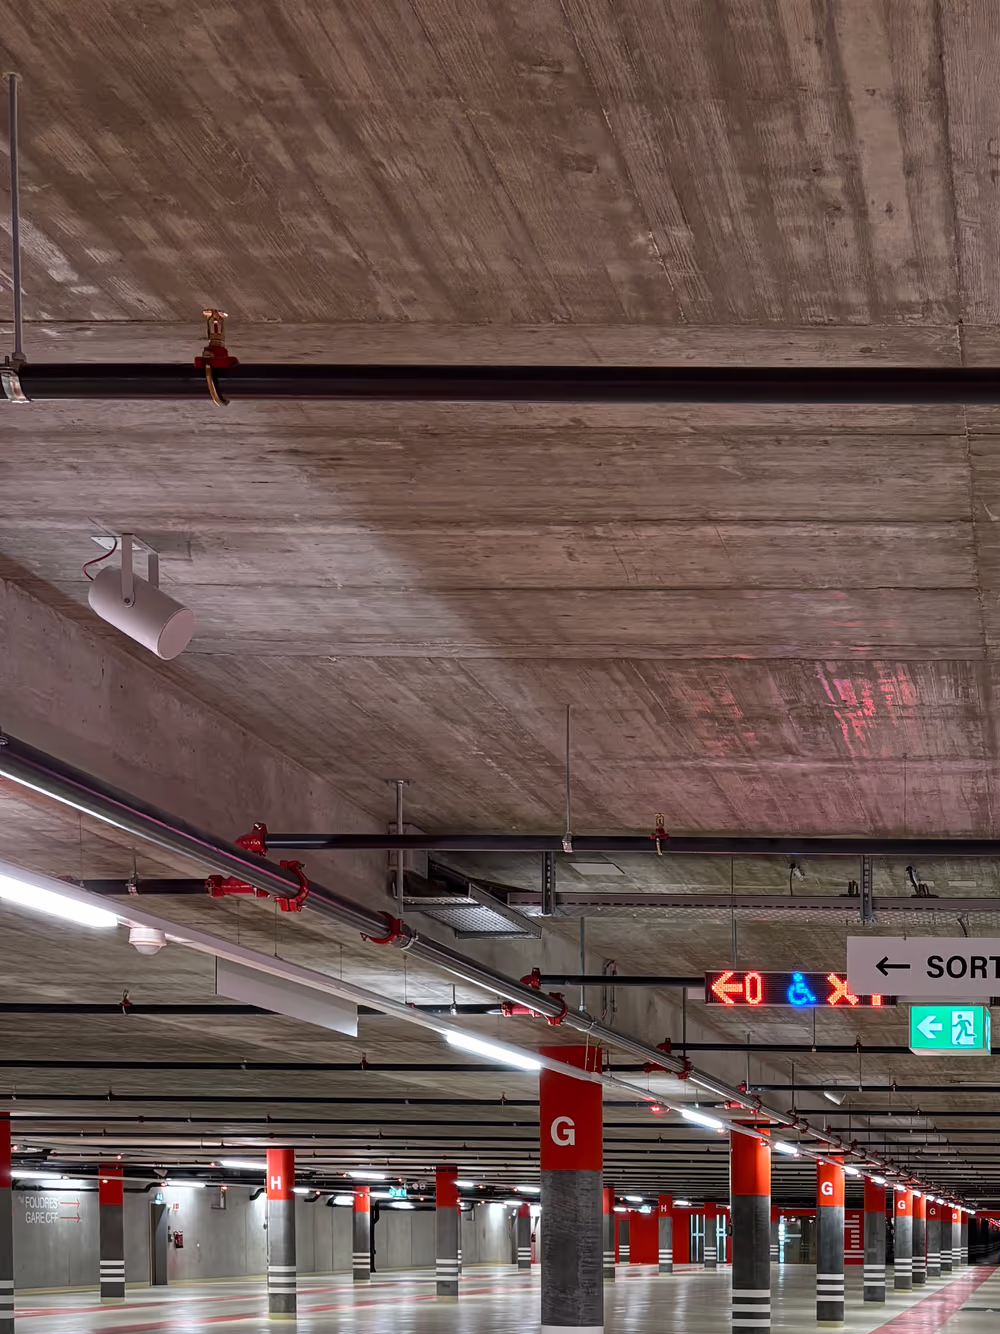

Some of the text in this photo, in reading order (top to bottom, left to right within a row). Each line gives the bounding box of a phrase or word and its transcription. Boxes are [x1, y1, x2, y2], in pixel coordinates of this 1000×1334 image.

[550, 1116, 575, 1146] G
[270, 1175, 282, 1190] H
[821, 1181, 833, 1196] G
[25, 1196, 58, 1209] FOUDRES
[660, 1204, 667, 1213] H
[897, 1200, 906, 1210] G
[25, 1211, 45, 1224] GARE
